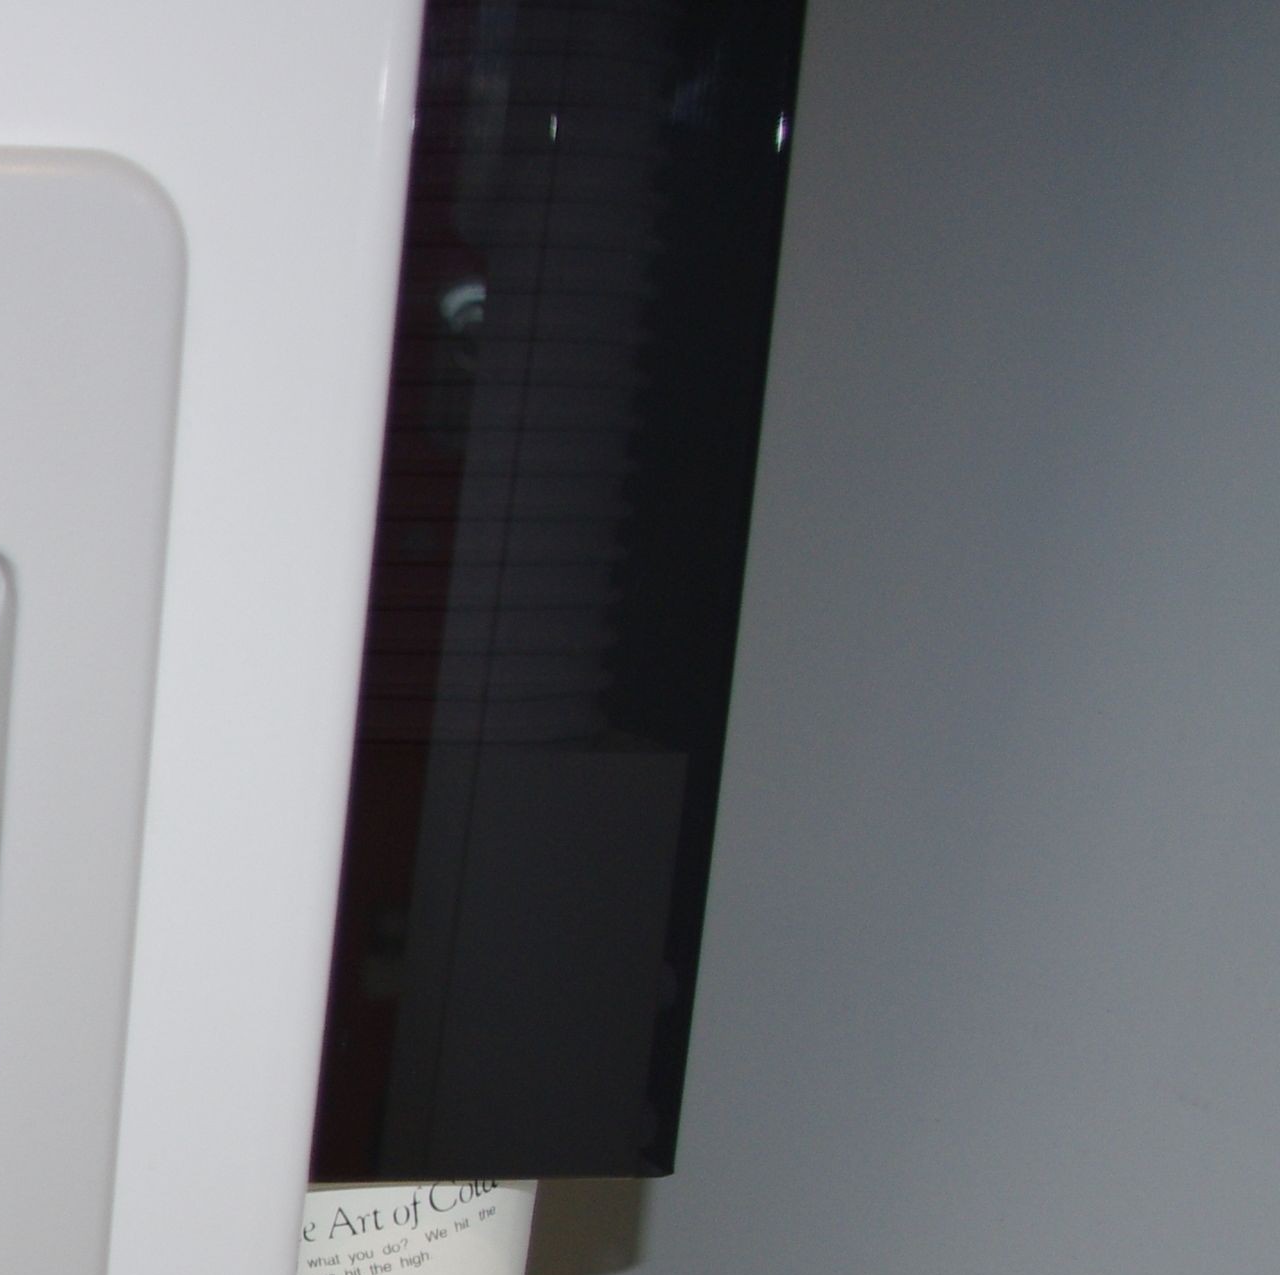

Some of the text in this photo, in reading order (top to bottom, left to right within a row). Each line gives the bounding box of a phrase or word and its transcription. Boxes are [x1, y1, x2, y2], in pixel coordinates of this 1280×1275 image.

[307, 1205, 497, 1269] what you do? We hit the
[328, 1206, 384, 1240] Art
[393, 1184, 423, 1230] of
